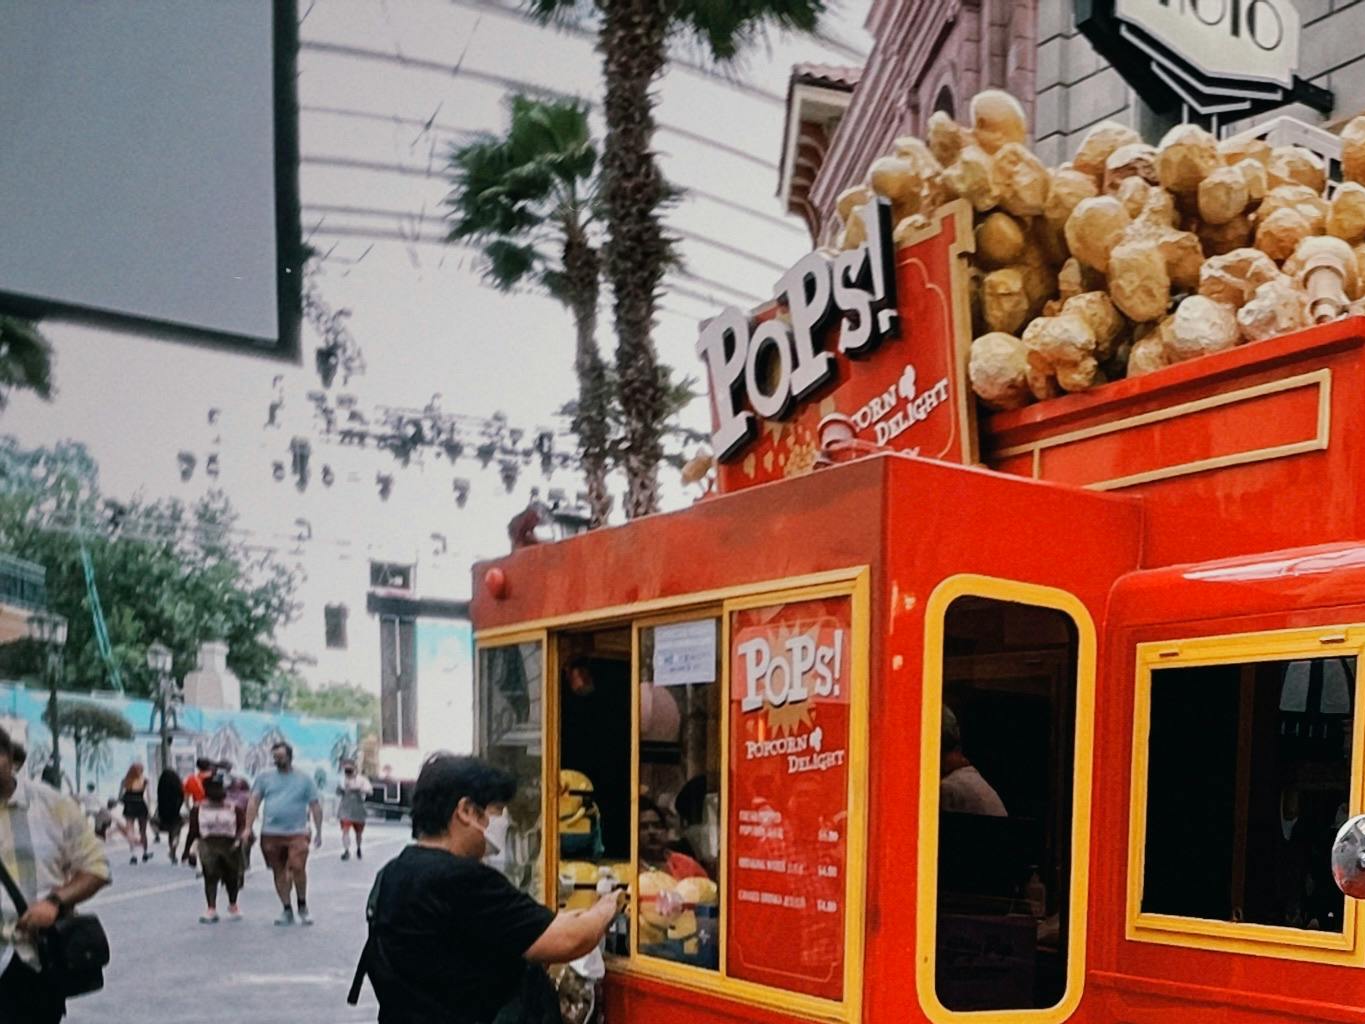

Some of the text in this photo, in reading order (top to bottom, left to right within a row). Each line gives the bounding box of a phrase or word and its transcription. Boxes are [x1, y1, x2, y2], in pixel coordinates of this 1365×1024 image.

[874, 377, 949, 447] DELIGHT
[745, 734, 808, 759] POPCORN
[787, 749, 845, 774] DELIGHT
